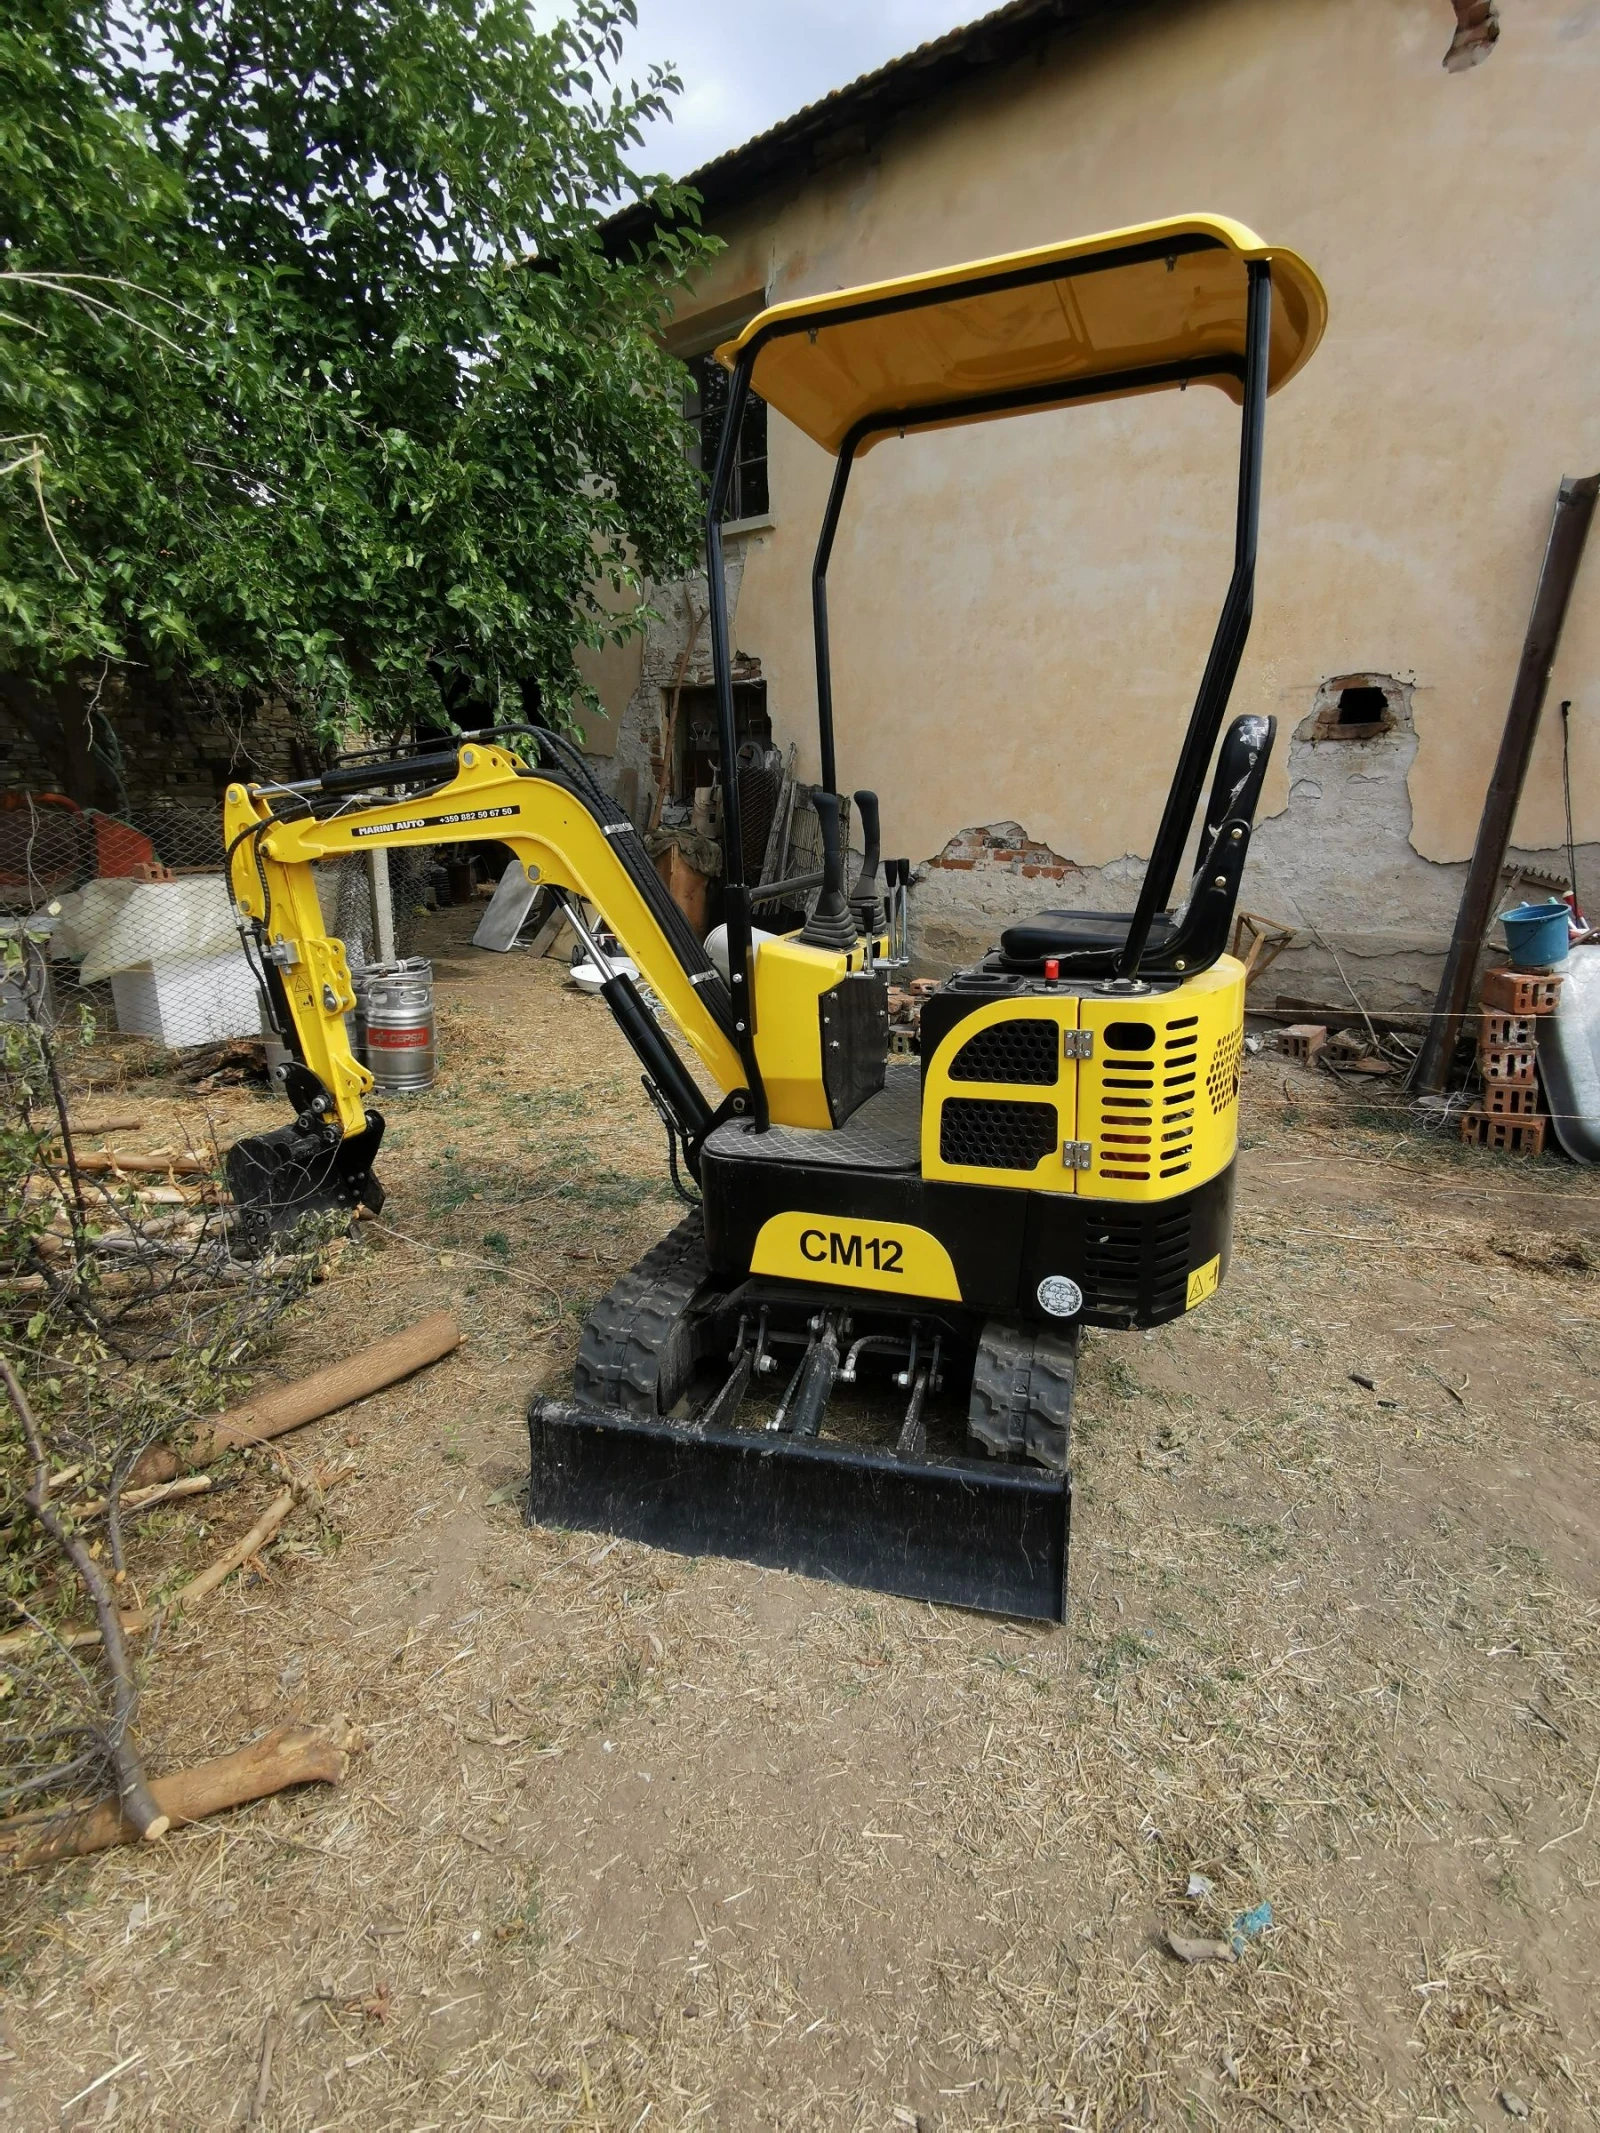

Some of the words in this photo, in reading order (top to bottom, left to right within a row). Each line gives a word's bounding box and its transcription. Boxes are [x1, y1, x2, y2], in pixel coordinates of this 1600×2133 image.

[359, 824, 394, 835] MARINI
[396, 819, 425, 829] AUTO
[439, 814, 460, 823] +359
[461, 812, 476, 821] 882
[477, 810, 488, 819] 50
[489, 809, 499, 817] 67
[502, 807, 512, 815] 50
[799, 1229, 904, 1274] CM12
